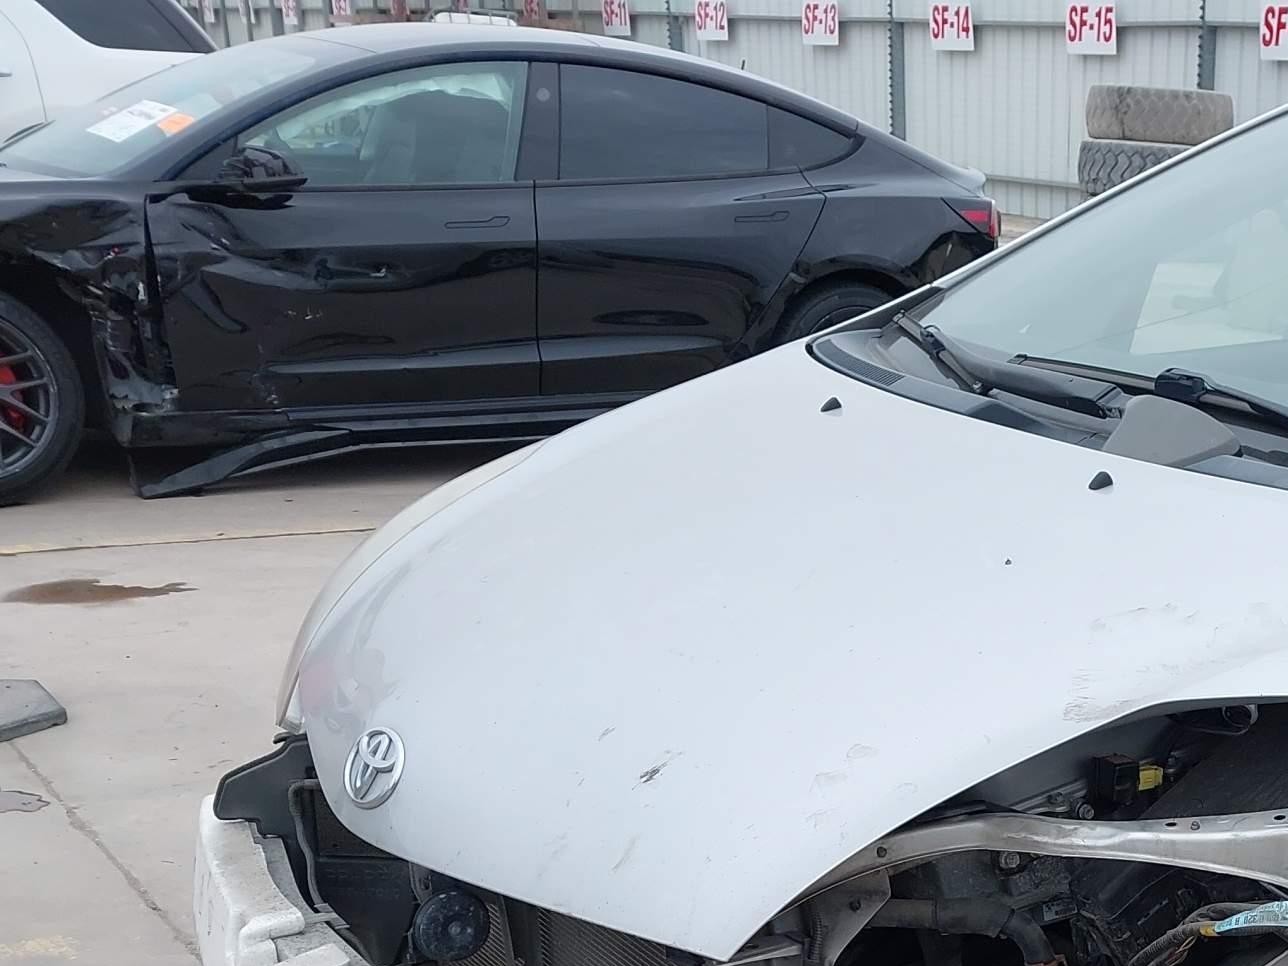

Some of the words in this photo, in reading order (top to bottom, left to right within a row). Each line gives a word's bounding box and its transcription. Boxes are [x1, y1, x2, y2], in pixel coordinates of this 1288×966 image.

[603, 0, 627, 26] SF-11
[697, 1, 725, 30] SF-12
[804, 3, 836, 34] SF-13
[932, 5, 969, 39] SF-14
[1068, 6, 1113, 42] SF-15
